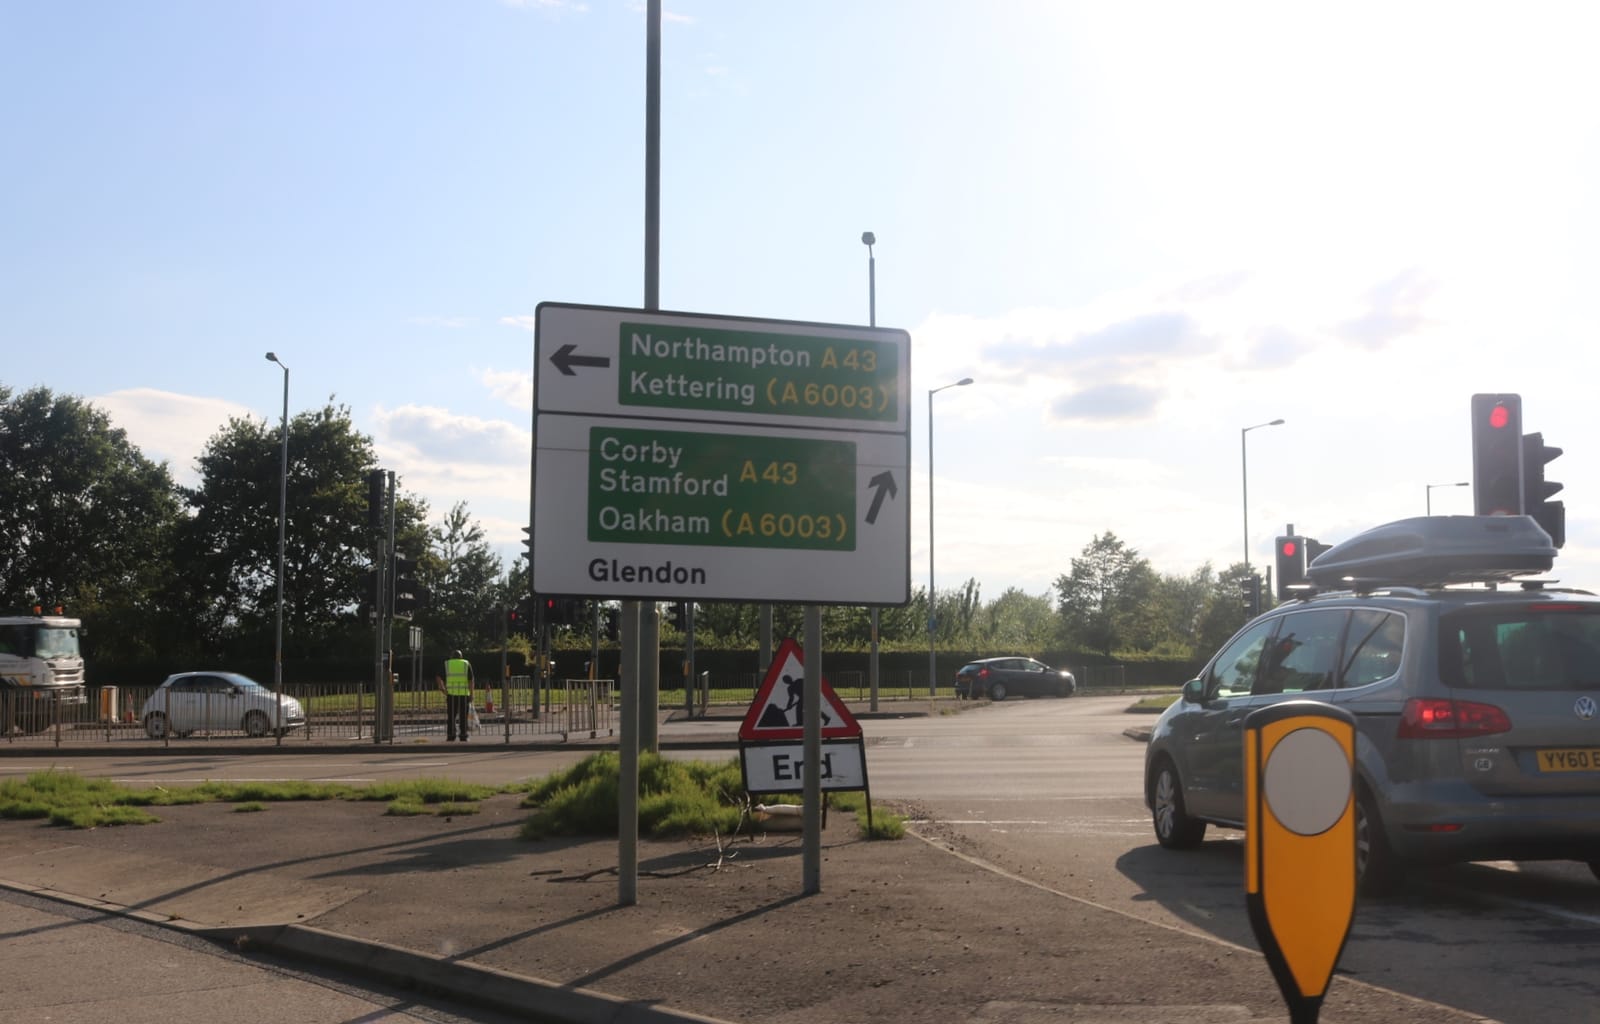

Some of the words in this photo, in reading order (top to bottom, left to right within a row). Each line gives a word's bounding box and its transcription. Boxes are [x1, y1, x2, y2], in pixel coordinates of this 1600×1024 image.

[631, 332, 810, 369] Northampton
[630, 370, 756, 406] Kettering
[600, 437, 682, 469] Corby
[600, 468, 728, 496] Stamford
[599, 506, 710, 533] Oakham
[588, 558, 706, 584] Glendon
[1544, 751, 1589, 768] YY60
